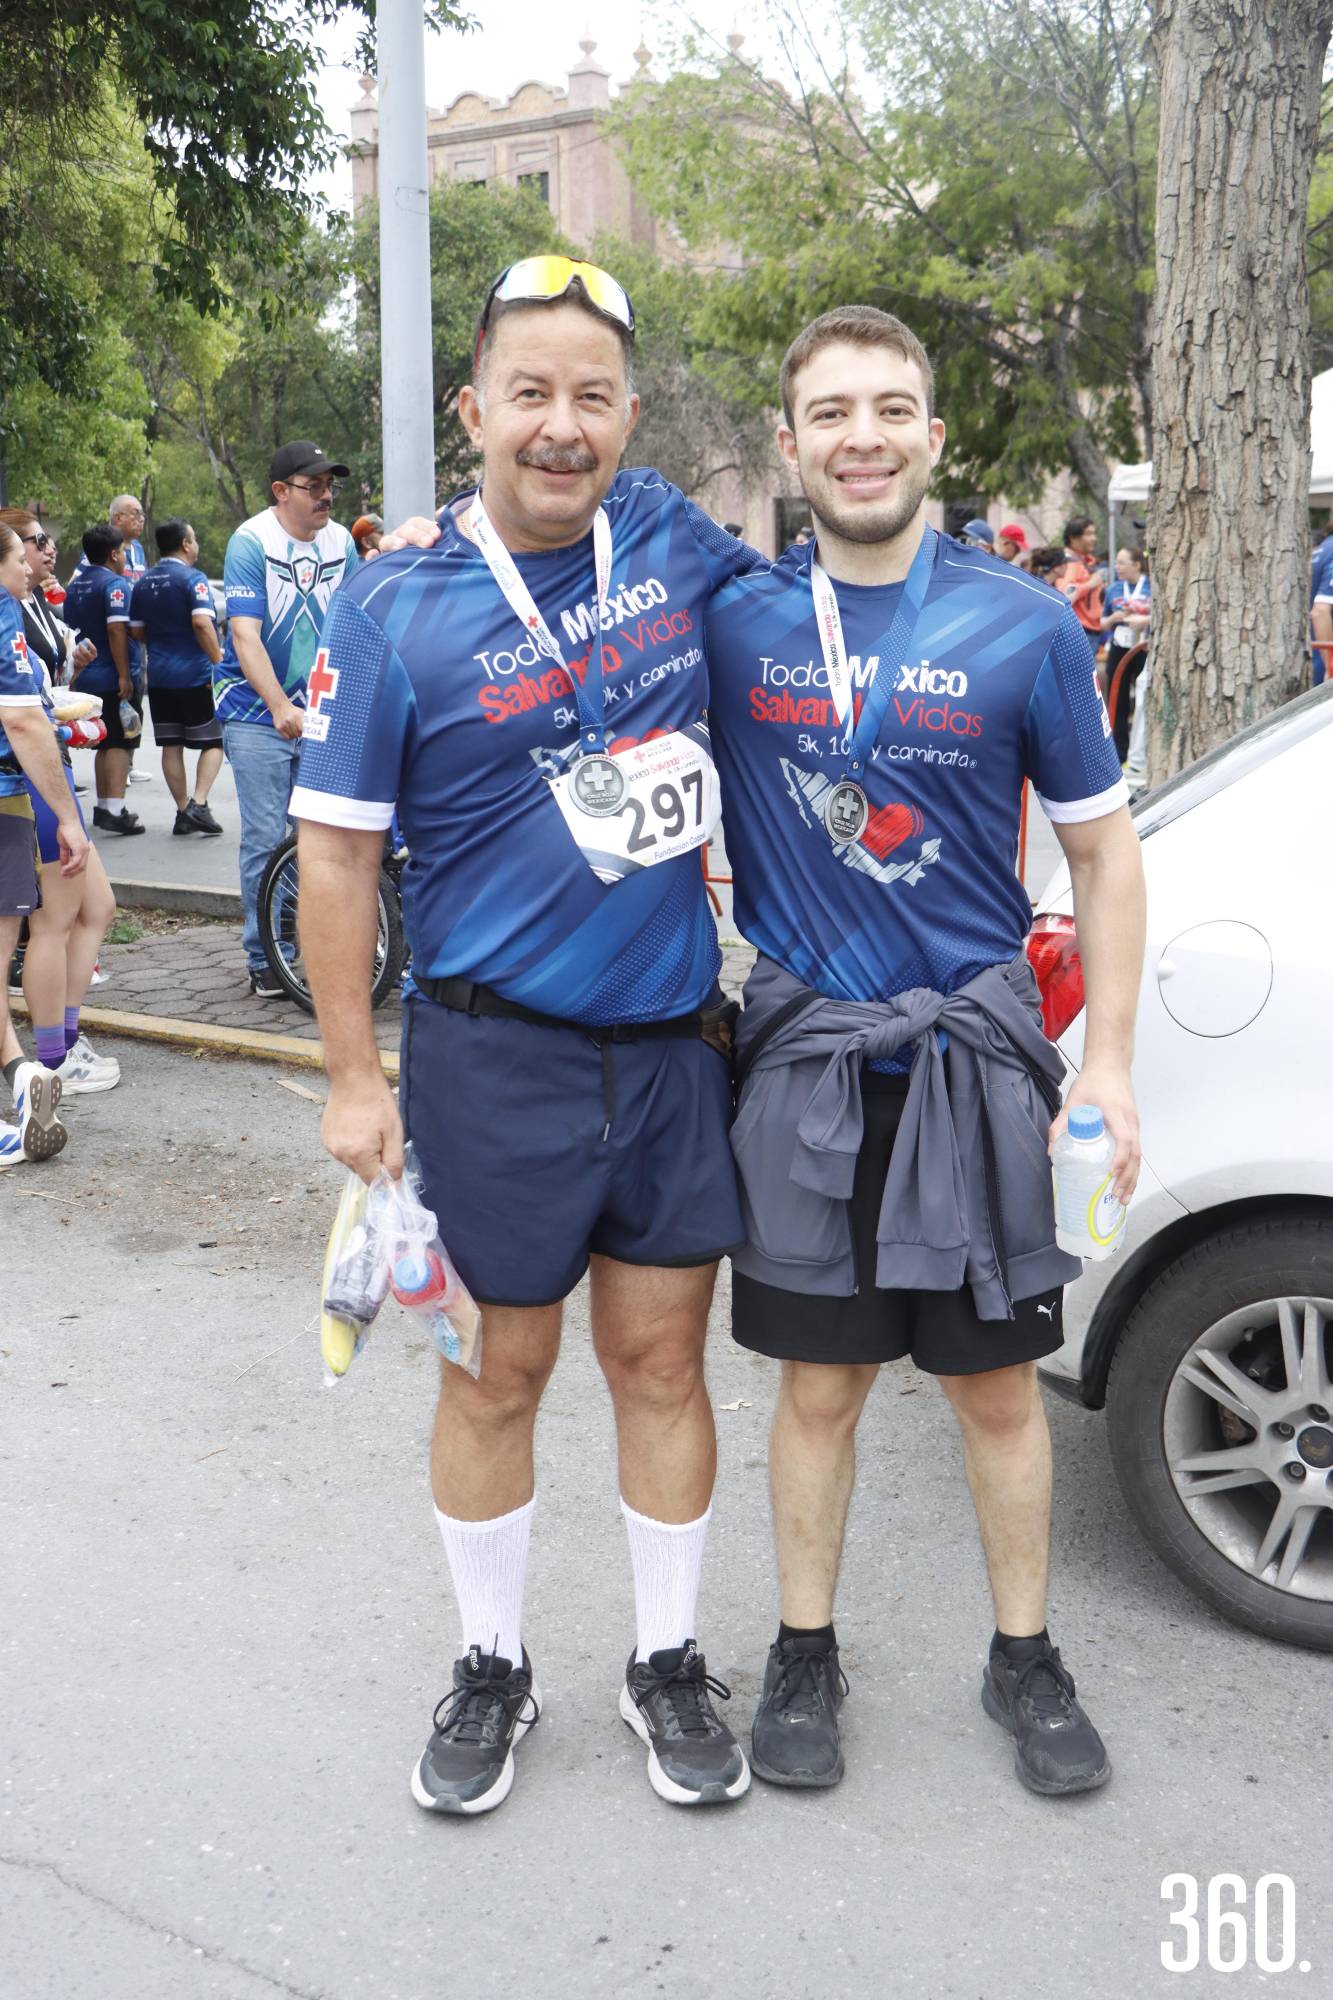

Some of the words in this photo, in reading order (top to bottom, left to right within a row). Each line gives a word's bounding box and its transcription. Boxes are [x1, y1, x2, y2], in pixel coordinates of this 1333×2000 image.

[619, 608, 693, 653] Vidas
[759, 657, 831, 688] Todo
[848, 655, 969, 698] Mxico
[894, 698, 985, 737] Vidas
[798, 734, 824, 758] 5k,
[829, 736, 851, 755] 10
[871, 744, 882, 760] y
[612, 768, 704, 854] 297
